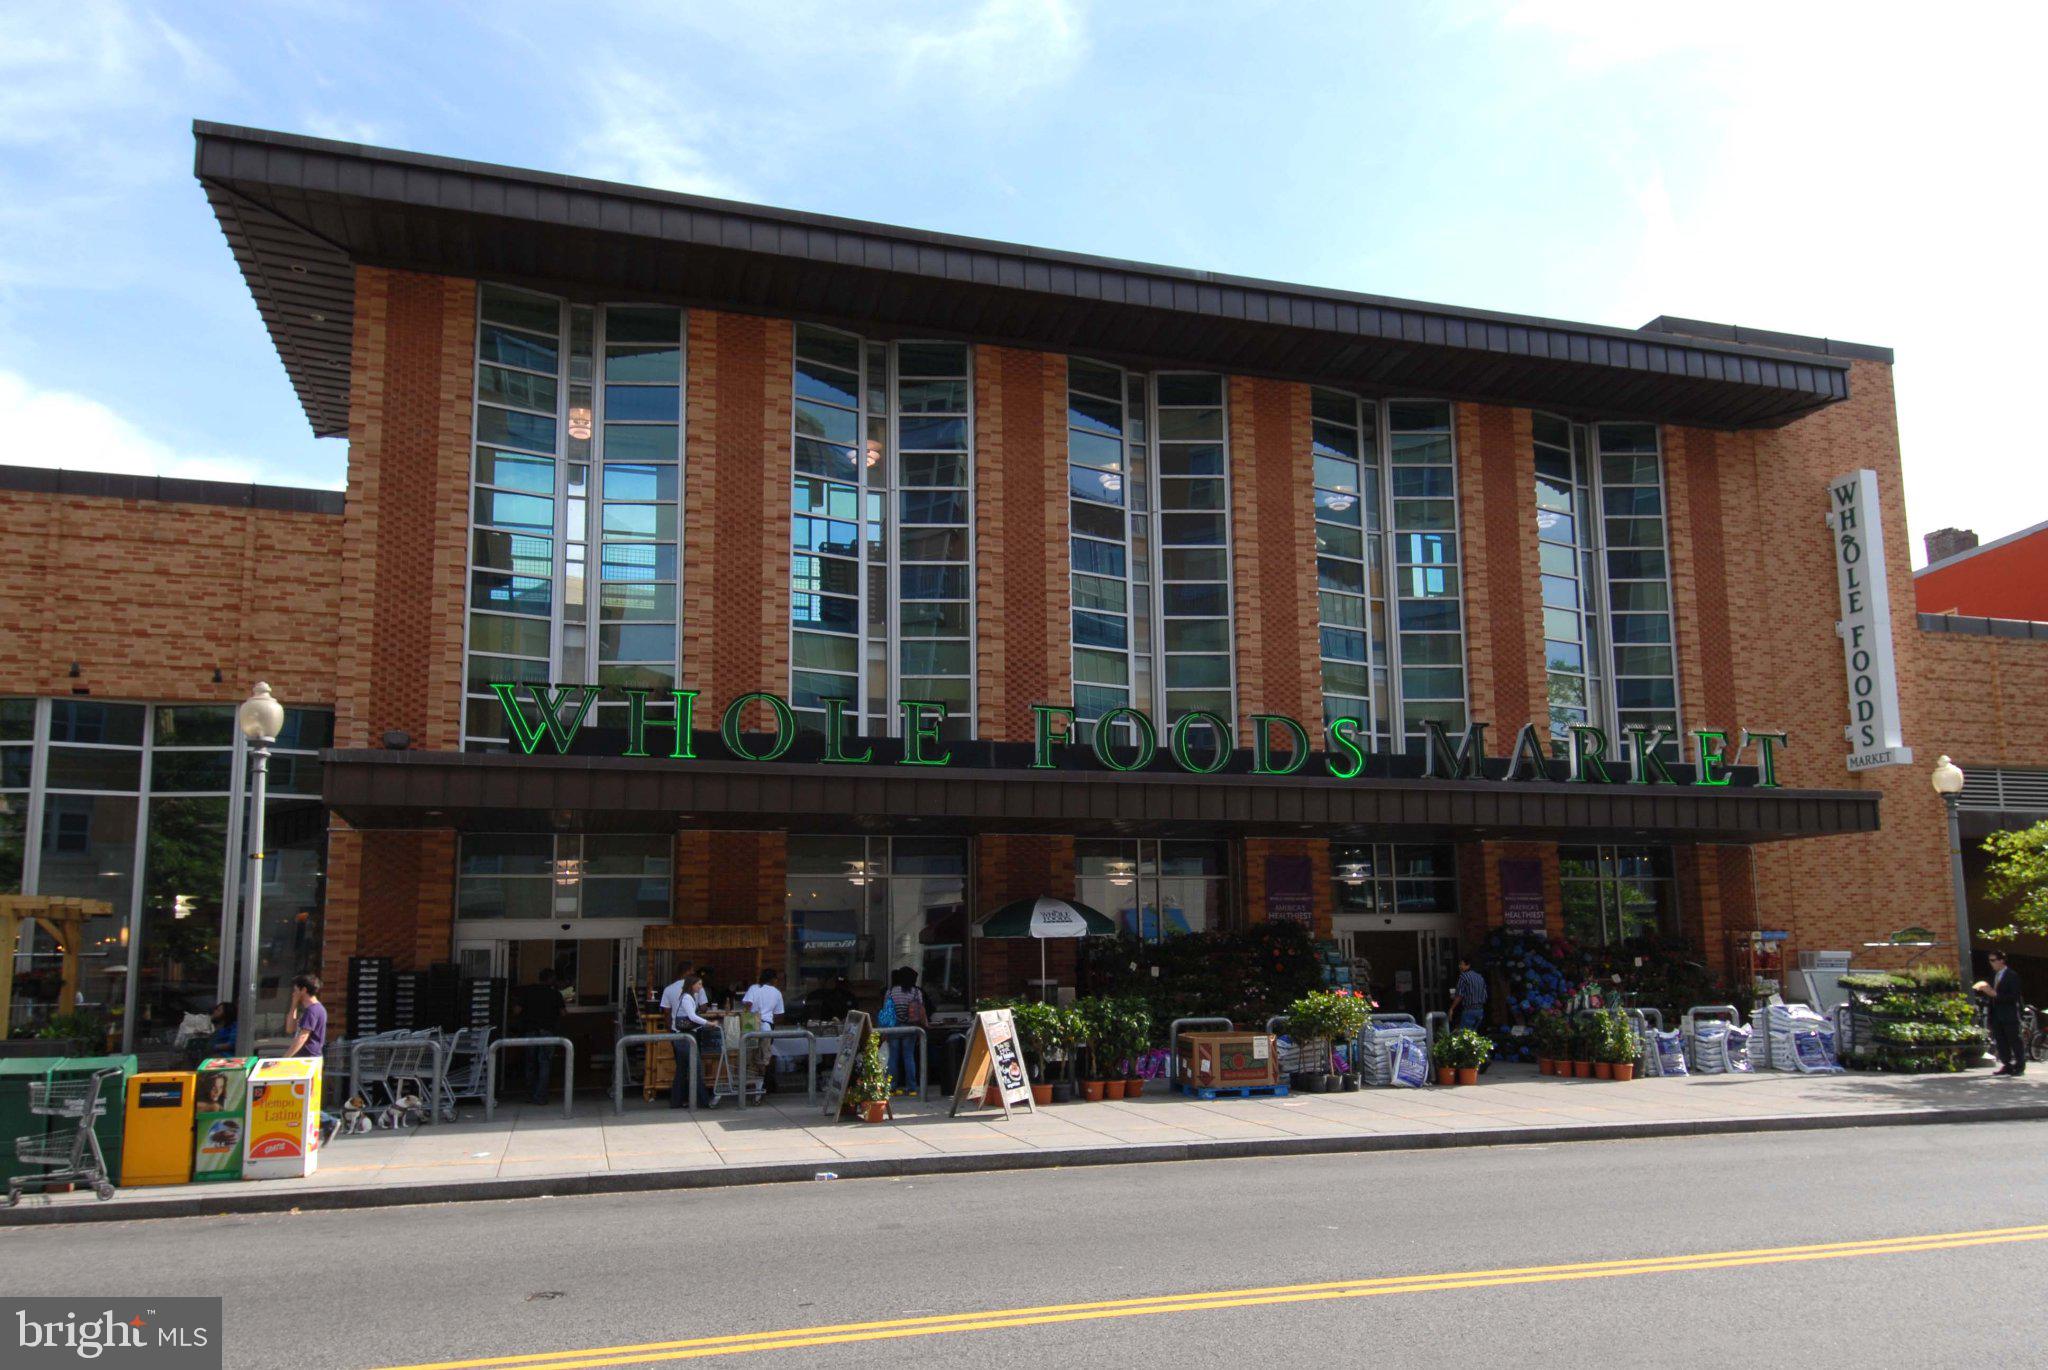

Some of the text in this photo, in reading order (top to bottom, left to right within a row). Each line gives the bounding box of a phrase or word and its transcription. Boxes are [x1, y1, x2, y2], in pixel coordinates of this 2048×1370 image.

[1834, 482, 1875, 748] WHOLE FOODS
[487, 683, 1788, 790] WHOLE FOODS MARKET
[1850, 751, 1892, 769] MARKET
[265, 1110, 302, 1122] Latino
